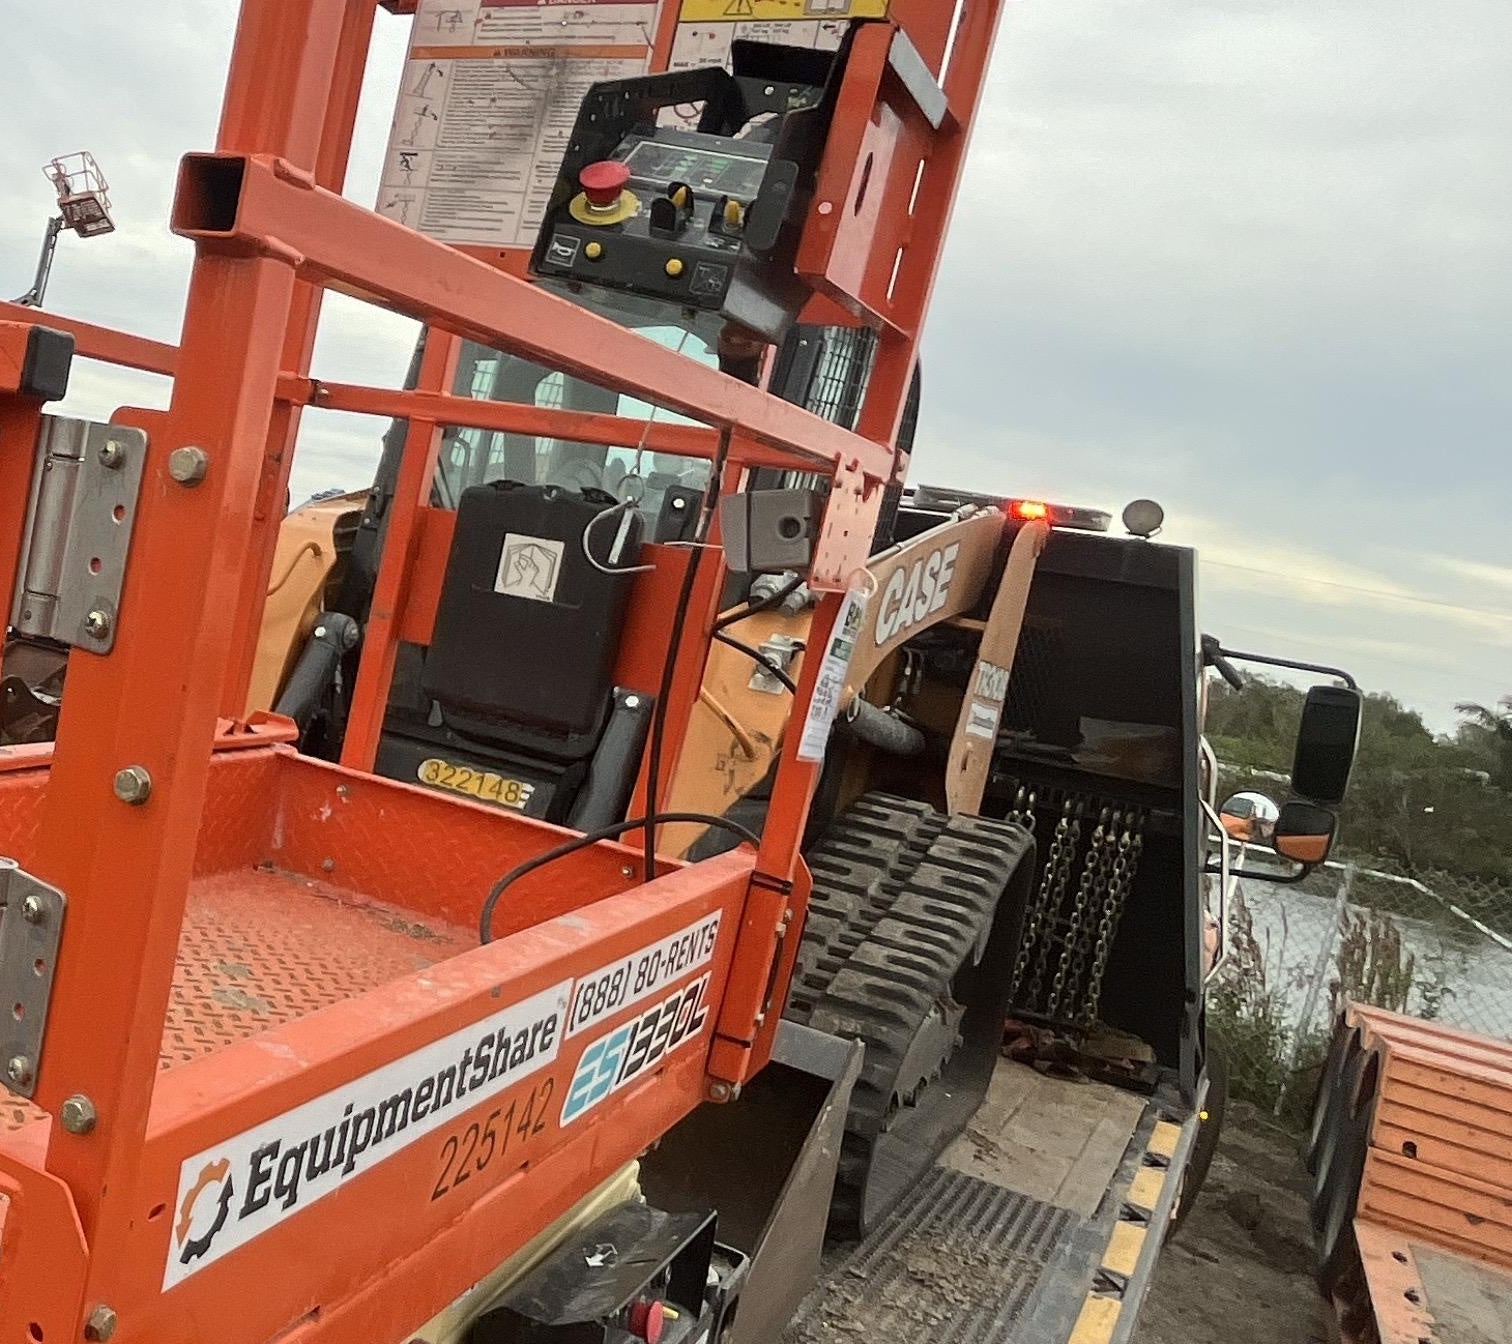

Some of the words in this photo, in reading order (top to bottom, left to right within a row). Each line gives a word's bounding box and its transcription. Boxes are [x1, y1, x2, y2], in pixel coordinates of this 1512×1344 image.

[874, 542, 960, 646] CASE
[424, 763, 521, 803] 322148
[569, 961, 633, 1034] (888)
[633, 920, 717, 997] 80-RENTS
[238, 1012, 557, 1220] EquipmentShare
[430, 1077, 556, 1202] 225142
